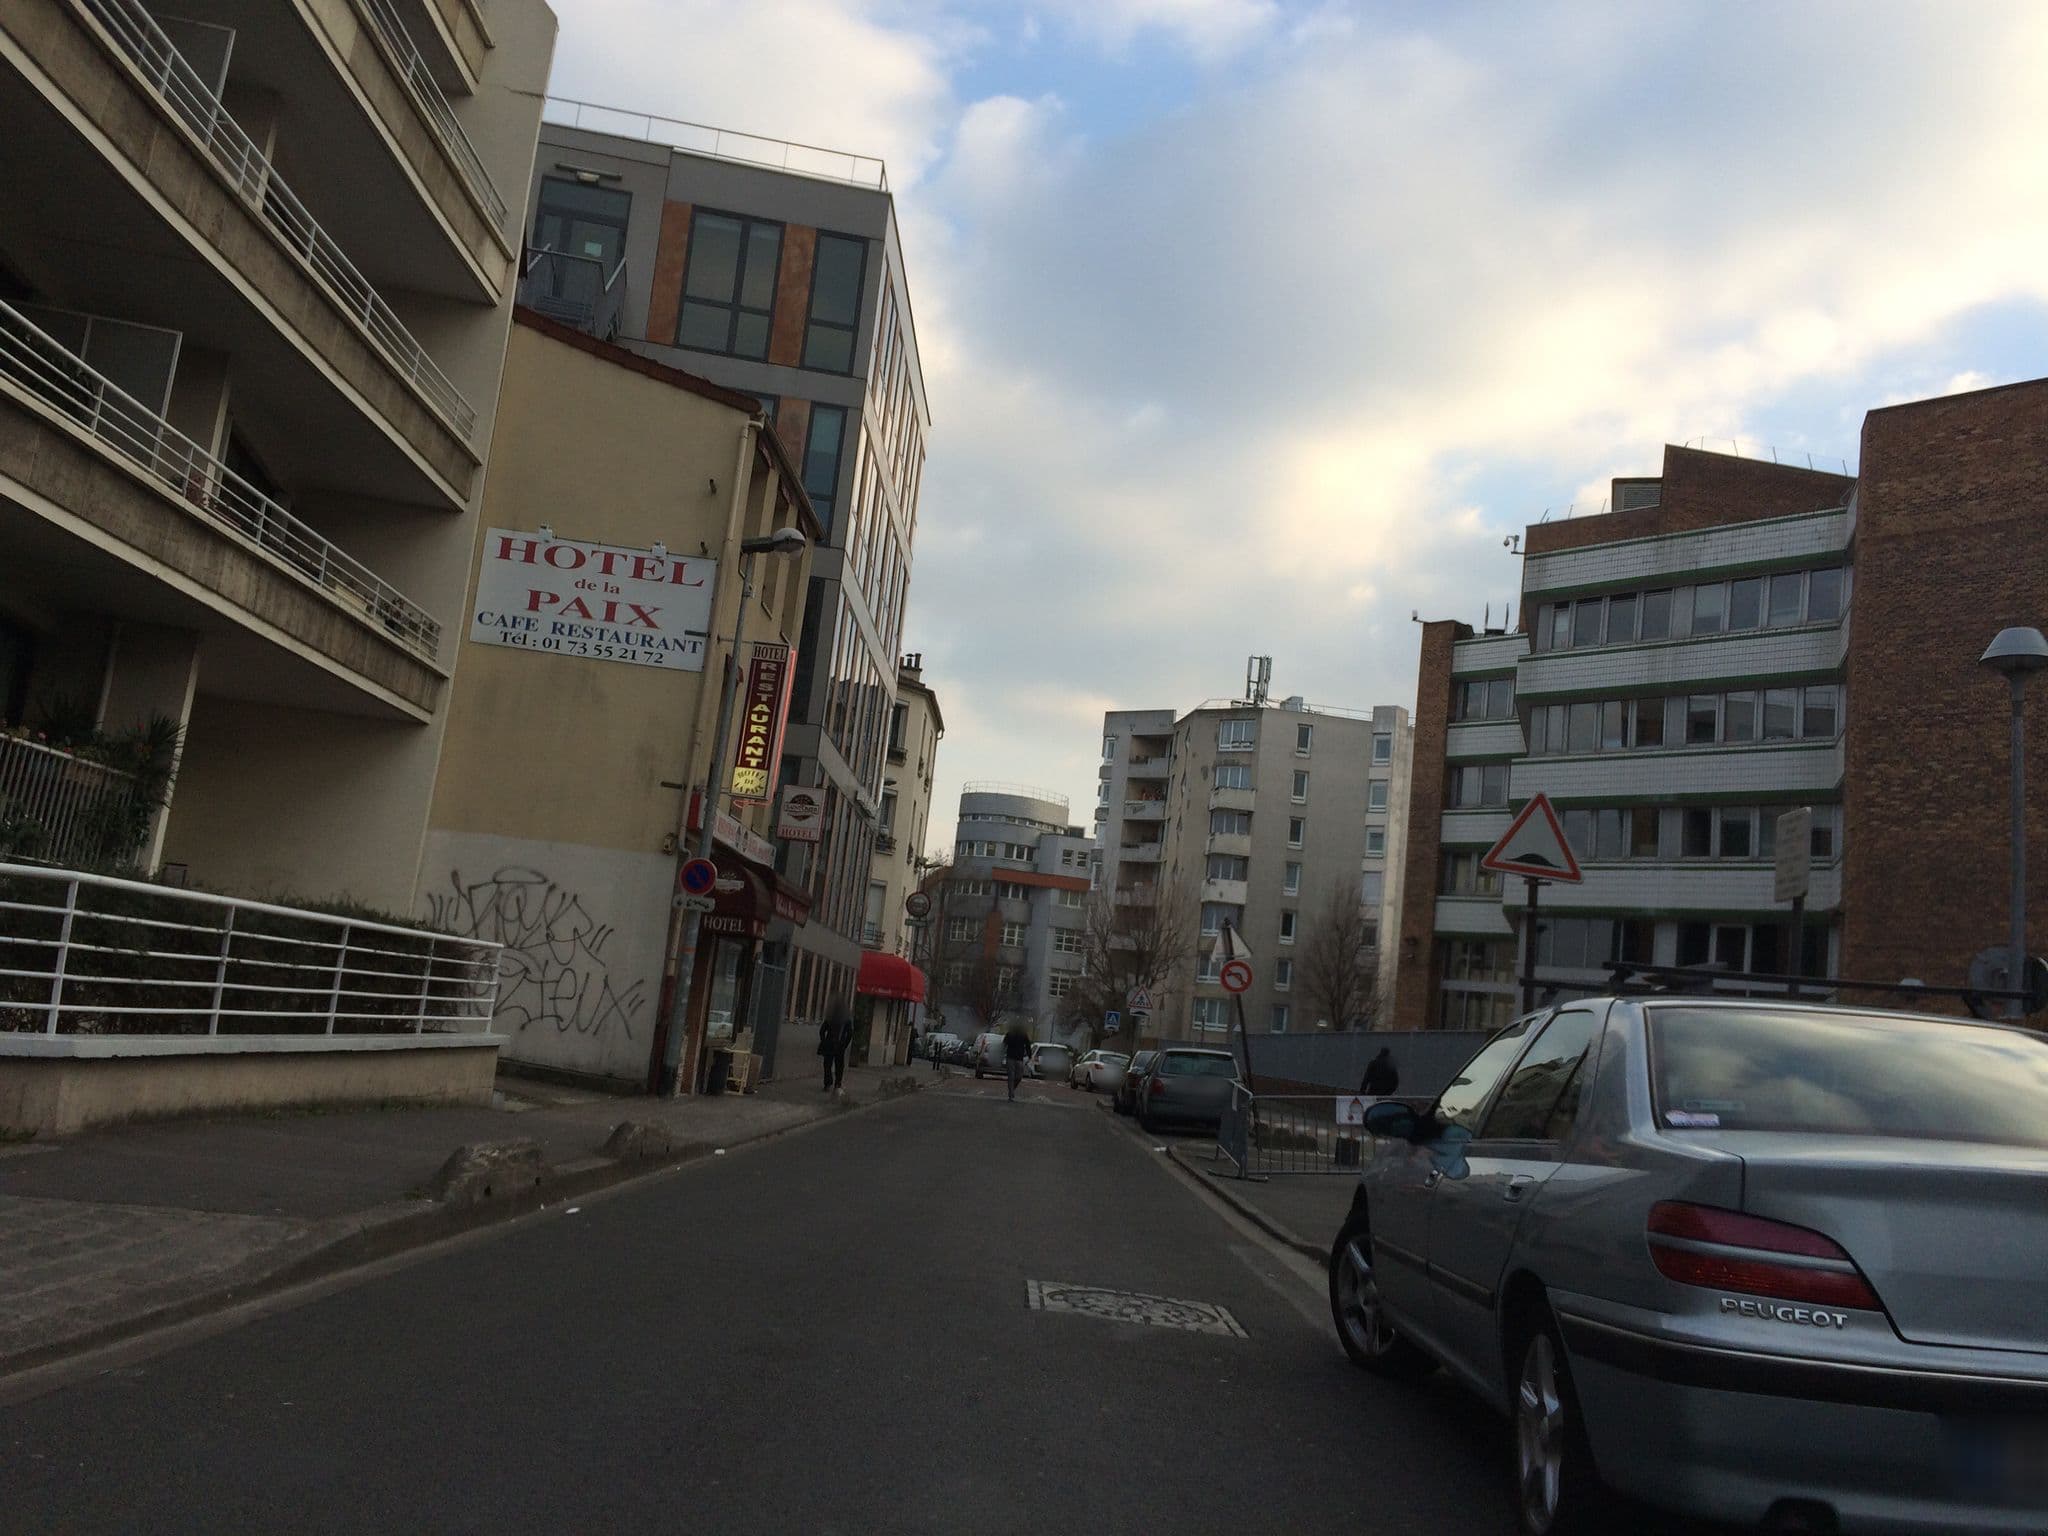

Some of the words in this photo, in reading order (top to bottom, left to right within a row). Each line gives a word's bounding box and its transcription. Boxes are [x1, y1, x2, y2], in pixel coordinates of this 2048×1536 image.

[496, 536, 704, 588] HOTEL
[574, 578, 597, 592] de
[603, 581, 621, 595] la
[525, 588, 662, 630] PAIX
[542, 637, 562, 651] 01
[568, 640, 588, 656] 73
[593, 643, 613, 657] 55
[619, 647, 637, 661] 21
[644, 649, 664, 664] 72
[551, 620, 702, 654] RESTAURANT
[753, 645, 786, 662] HOTEL
[745, 661, 778, 768] RESTAURANT
[782, 827, 814, 839] HOTEL
[704, 914, 745, 933] HOTEL
[1719, 1297, 1849, 1330] PEUGEOT
